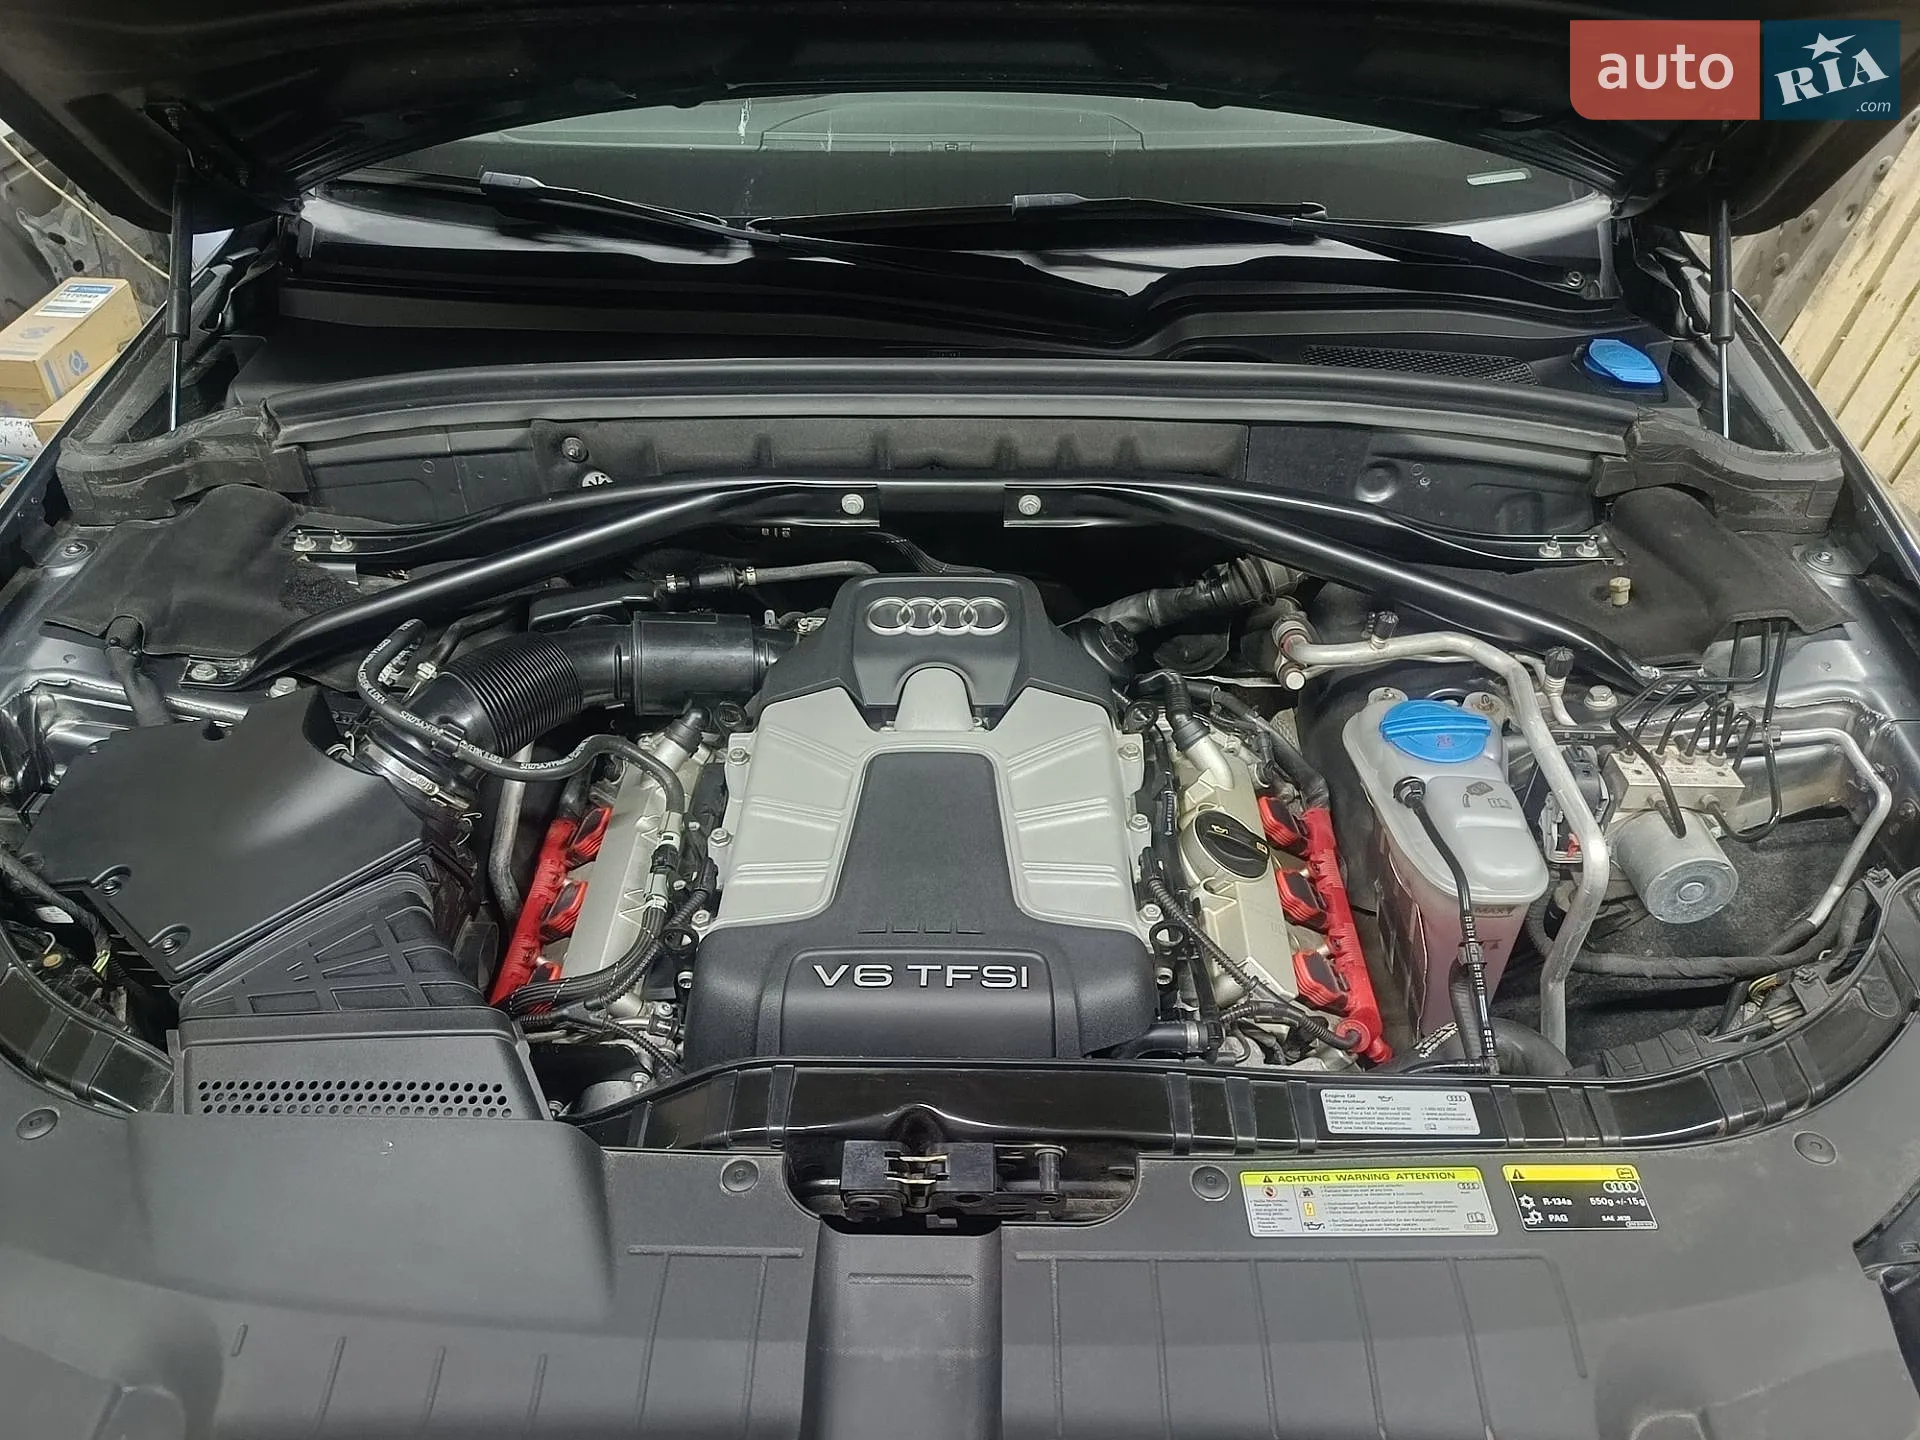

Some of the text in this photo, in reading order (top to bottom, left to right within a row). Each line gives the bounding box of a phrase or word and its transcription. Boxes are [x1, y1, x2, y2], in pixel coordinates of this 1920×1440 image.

[812, 964, 1029, 988] V6 TFSI
[1278, 1171, 1456, 1183] ACHTUNG WARNING ATTENTION
[1542, 1197, 1573, 1206] R-134a
